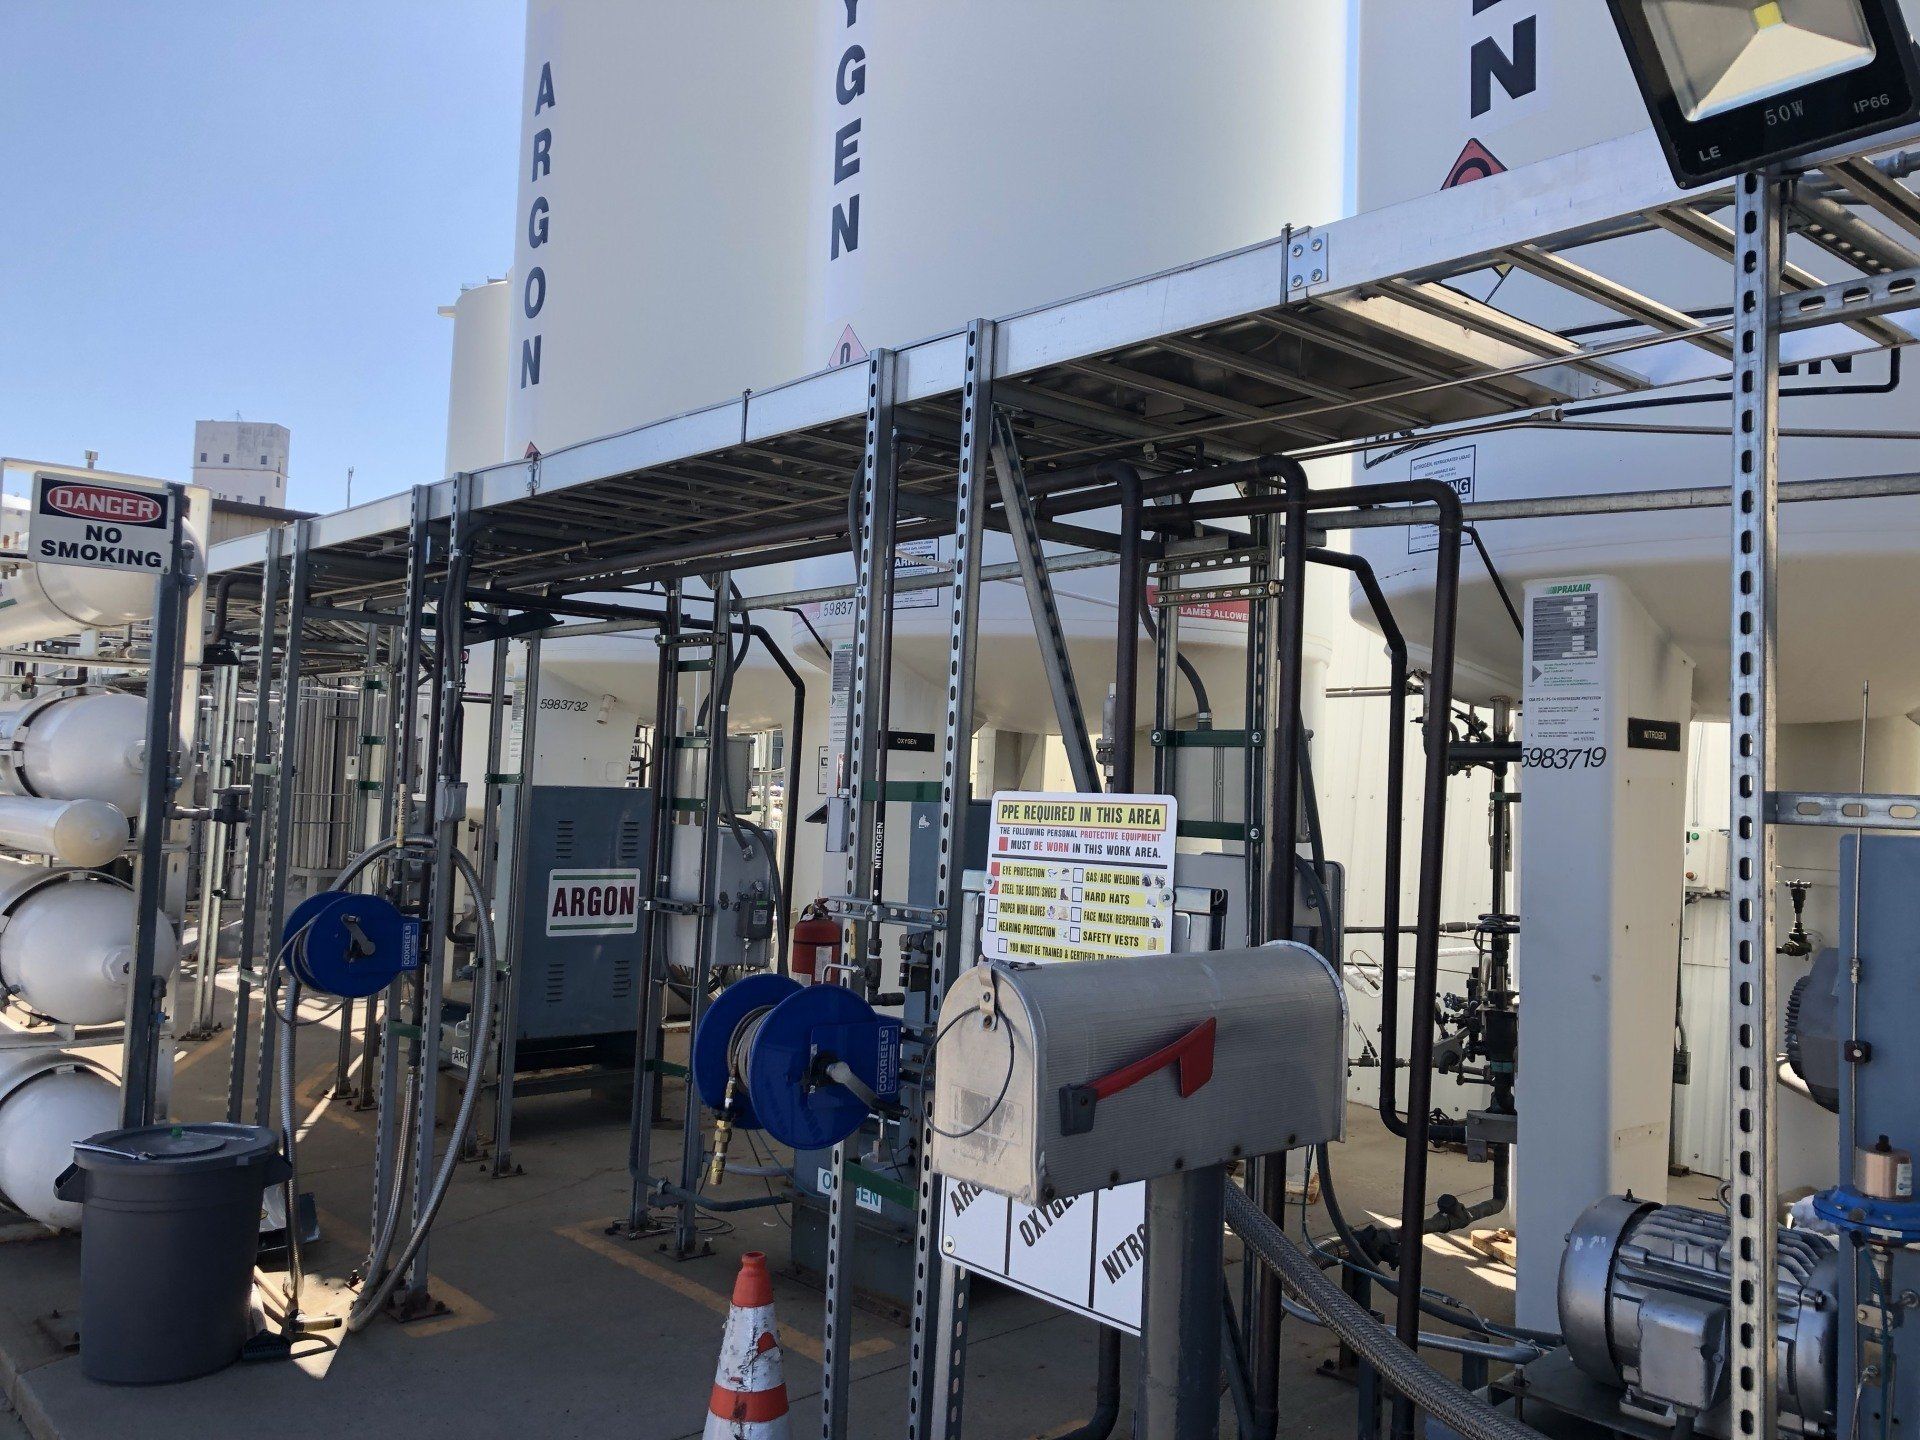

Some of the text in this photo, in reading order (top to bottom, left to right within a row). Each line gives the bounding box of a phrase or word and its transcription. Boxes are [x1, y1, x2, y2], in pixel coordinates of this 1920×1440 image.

[1765, 93, 1890, 126] 50W IP66
[1698, 145, 1722, 162] LE
[521, 61, 556, 389] ARGON
[55, 489, 154, 519] DANGER
[85, 524, 123, 544] NO
[40, 539, 162, 568] SMOKING
[1556, 583, 1592, 594] PRAXAIR
[1178, 606, 1250, 621] LAMES ALLOWE
[540, 698, 589, 712] 5983732
[896, 736, 917, 745] OXYGEN
[1001, 804, 1161, 825] PPE REQUIRED IN THIS AREA
[1000, 826, 1161, 842] THE FOLLOWING PERSONAL PROTECTIVE EQUIPMENT
[874, 821, 884, 869] NITROGEN
[1010, 839, 1161, 858] MUST BE WORN IN THIS WORK AREA.
[1002, 865, 1045, 878] EYE PROTECTION
[1113, 873, 1140, 886] WELDING
[1001, 883, 1015, 894] STEEL
[1016, 884, 1024, 895] TOE
[1084, 890, 1130, 905] HARD HATS
[551, 885, 635, 917] ARGON
[999, 902, 1015, 914] PROPER
[1029, 904, 1046, 917] GLOVES
[1083, 910, 1096, 922] FACE
[998, 921, 1056, 938] HEARING PROTECTION
[1082, 930, 1139, 947] SAFETY VESTS
[1009, 942, 1019, 953] YOU
[1020, 943, 1033, 955] MUST
[1034, 945, 1041, 956] BE
[1042, 946, 1063, 959] TRAINED
[879, 1029, 889, 1092] COXREELS
